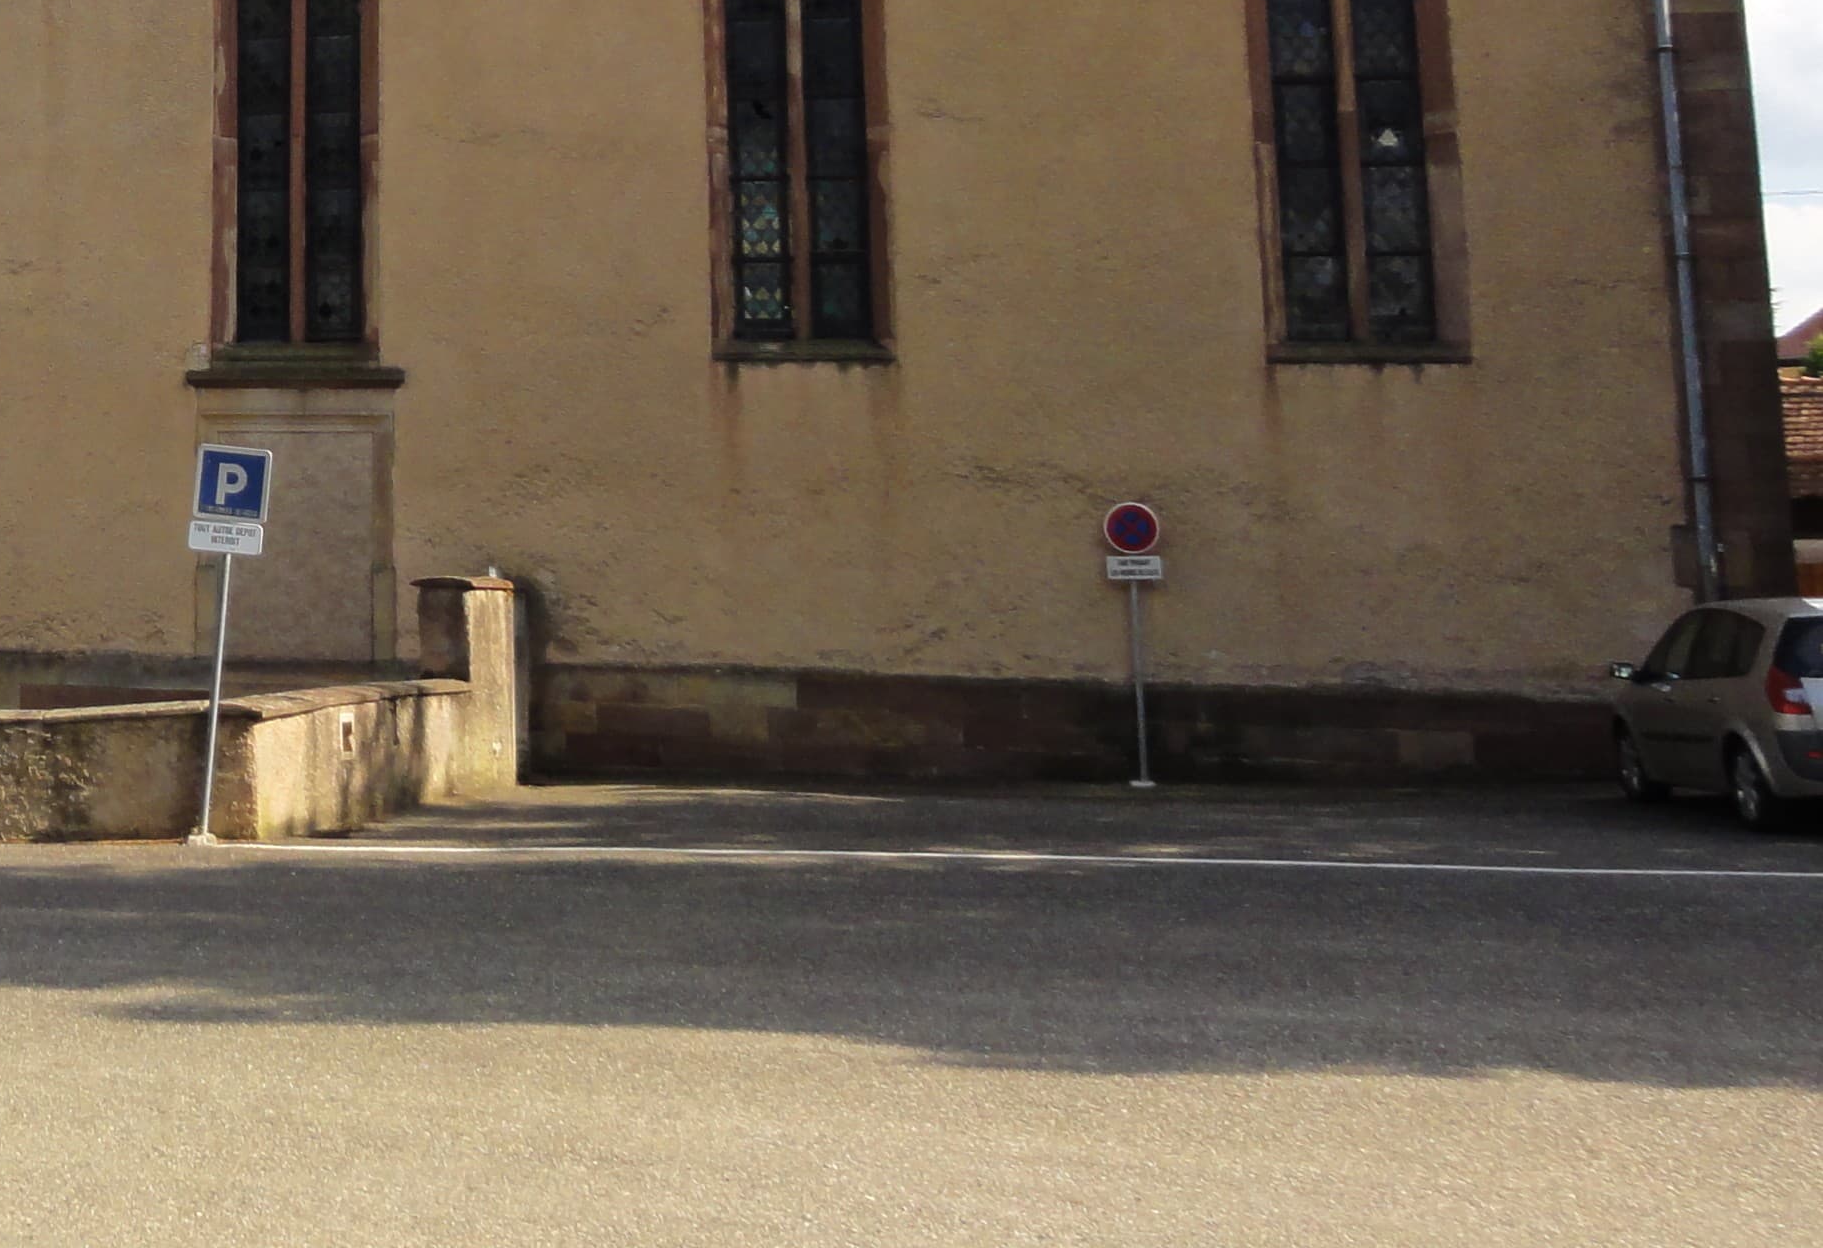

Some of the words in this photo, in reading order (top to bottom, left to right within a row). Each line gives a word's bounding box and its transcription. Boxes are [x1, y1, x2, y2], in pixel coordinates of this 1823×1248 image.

[215, 462, 248, 505] P
[193, 523, 210, 533] TOUT
[212, 525, 233, 535] AUTRE
